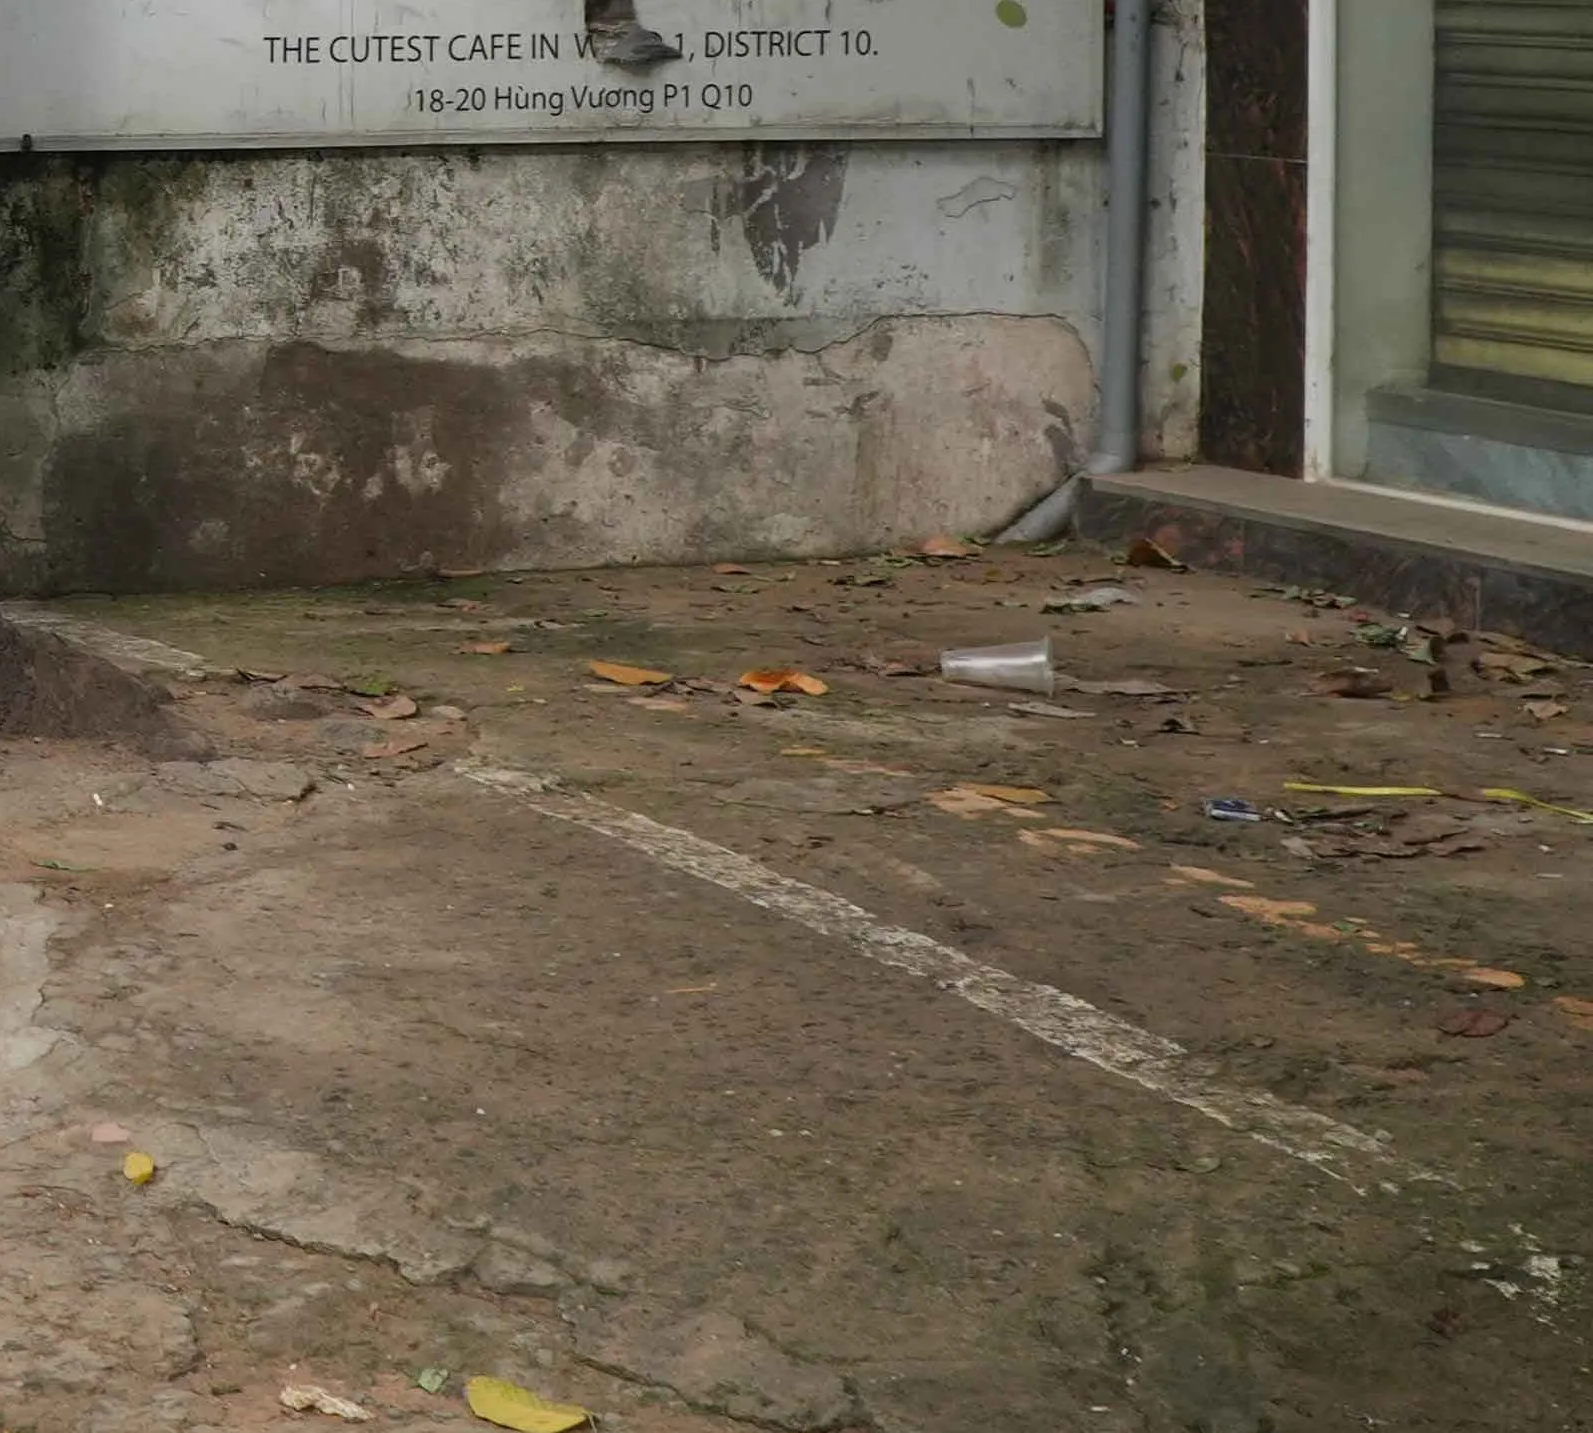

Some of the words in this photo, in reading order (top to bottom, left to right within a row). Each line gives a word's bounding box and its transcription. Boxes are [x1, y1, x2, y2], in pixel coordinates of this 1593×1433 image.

[264, 36, 320, 63] THE
[329, 35, 441, 63] CUTEST
[448, 33, 522, 61] CAFE
[532, 33, 559, 59] IN
[704, 30, 831, 58] DISTRICT
[840, 30, 879, 56] 10.
[415, 87, 486, 113] 18-20
[494, 85, 564, 116] Hùng
[570, 84, 655, 113] Vương
[664, 84, 689, 107] P1
[702, 83, 753, 109] Q10
